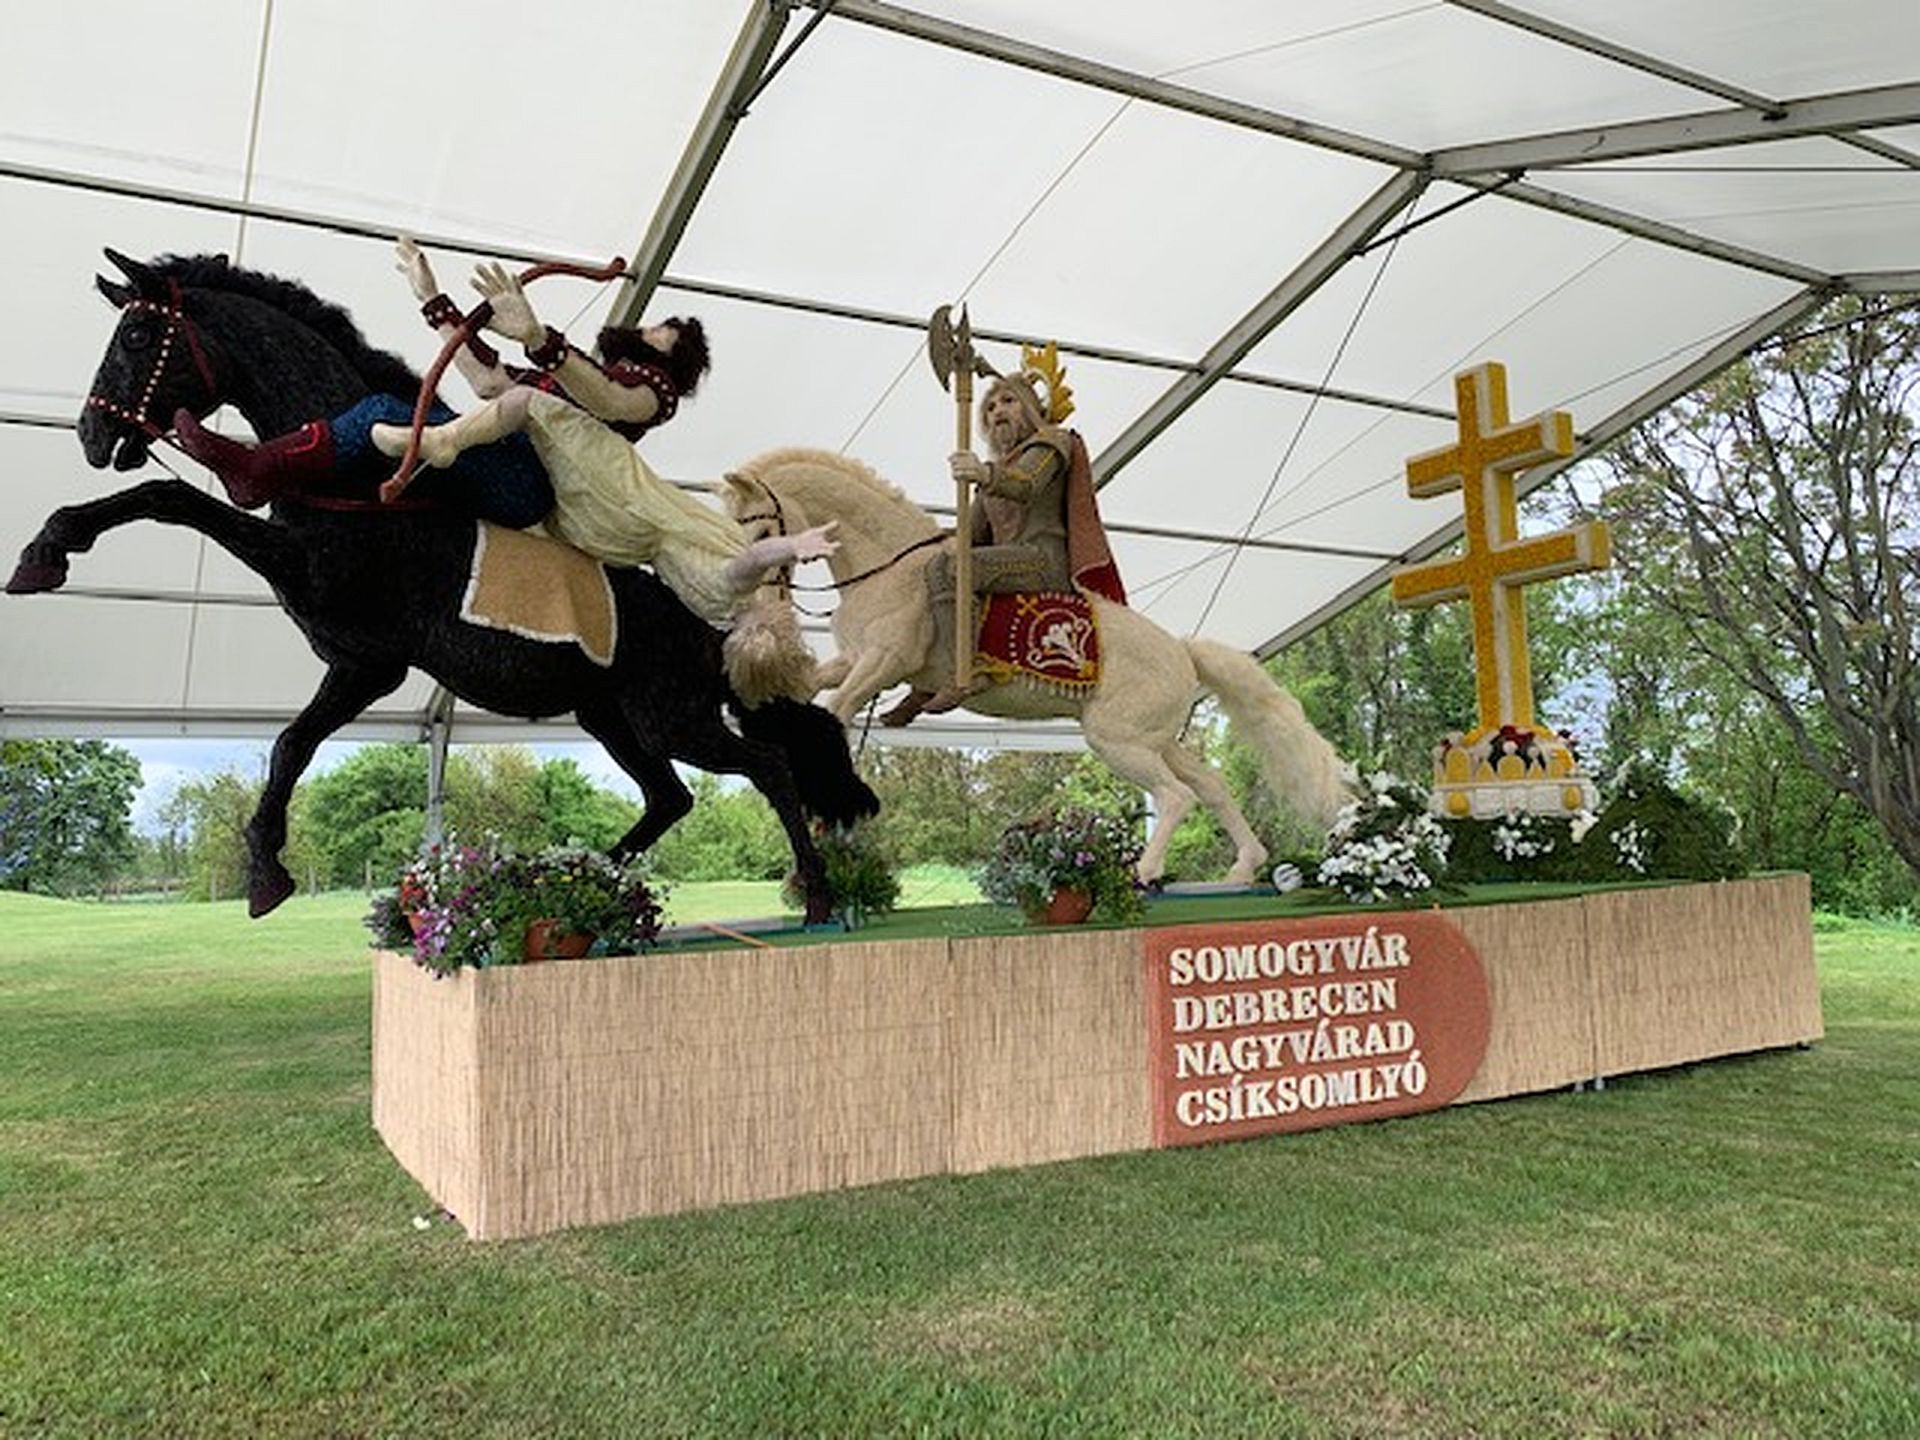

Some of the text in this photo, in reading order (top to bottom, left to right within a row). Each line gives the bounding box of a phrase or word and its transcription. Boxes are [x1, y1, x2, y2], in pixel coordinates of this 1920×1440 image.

[1169, 926, 1411, 986] SOMOGYVÁR
[1172, 978, 1398, 1032] DEBRECEN
[1174, 1018, 1415, 1079] NAGYVÁRAD
[1176, 1051, 1427, 1127] CSÍKSOMLYÓ
